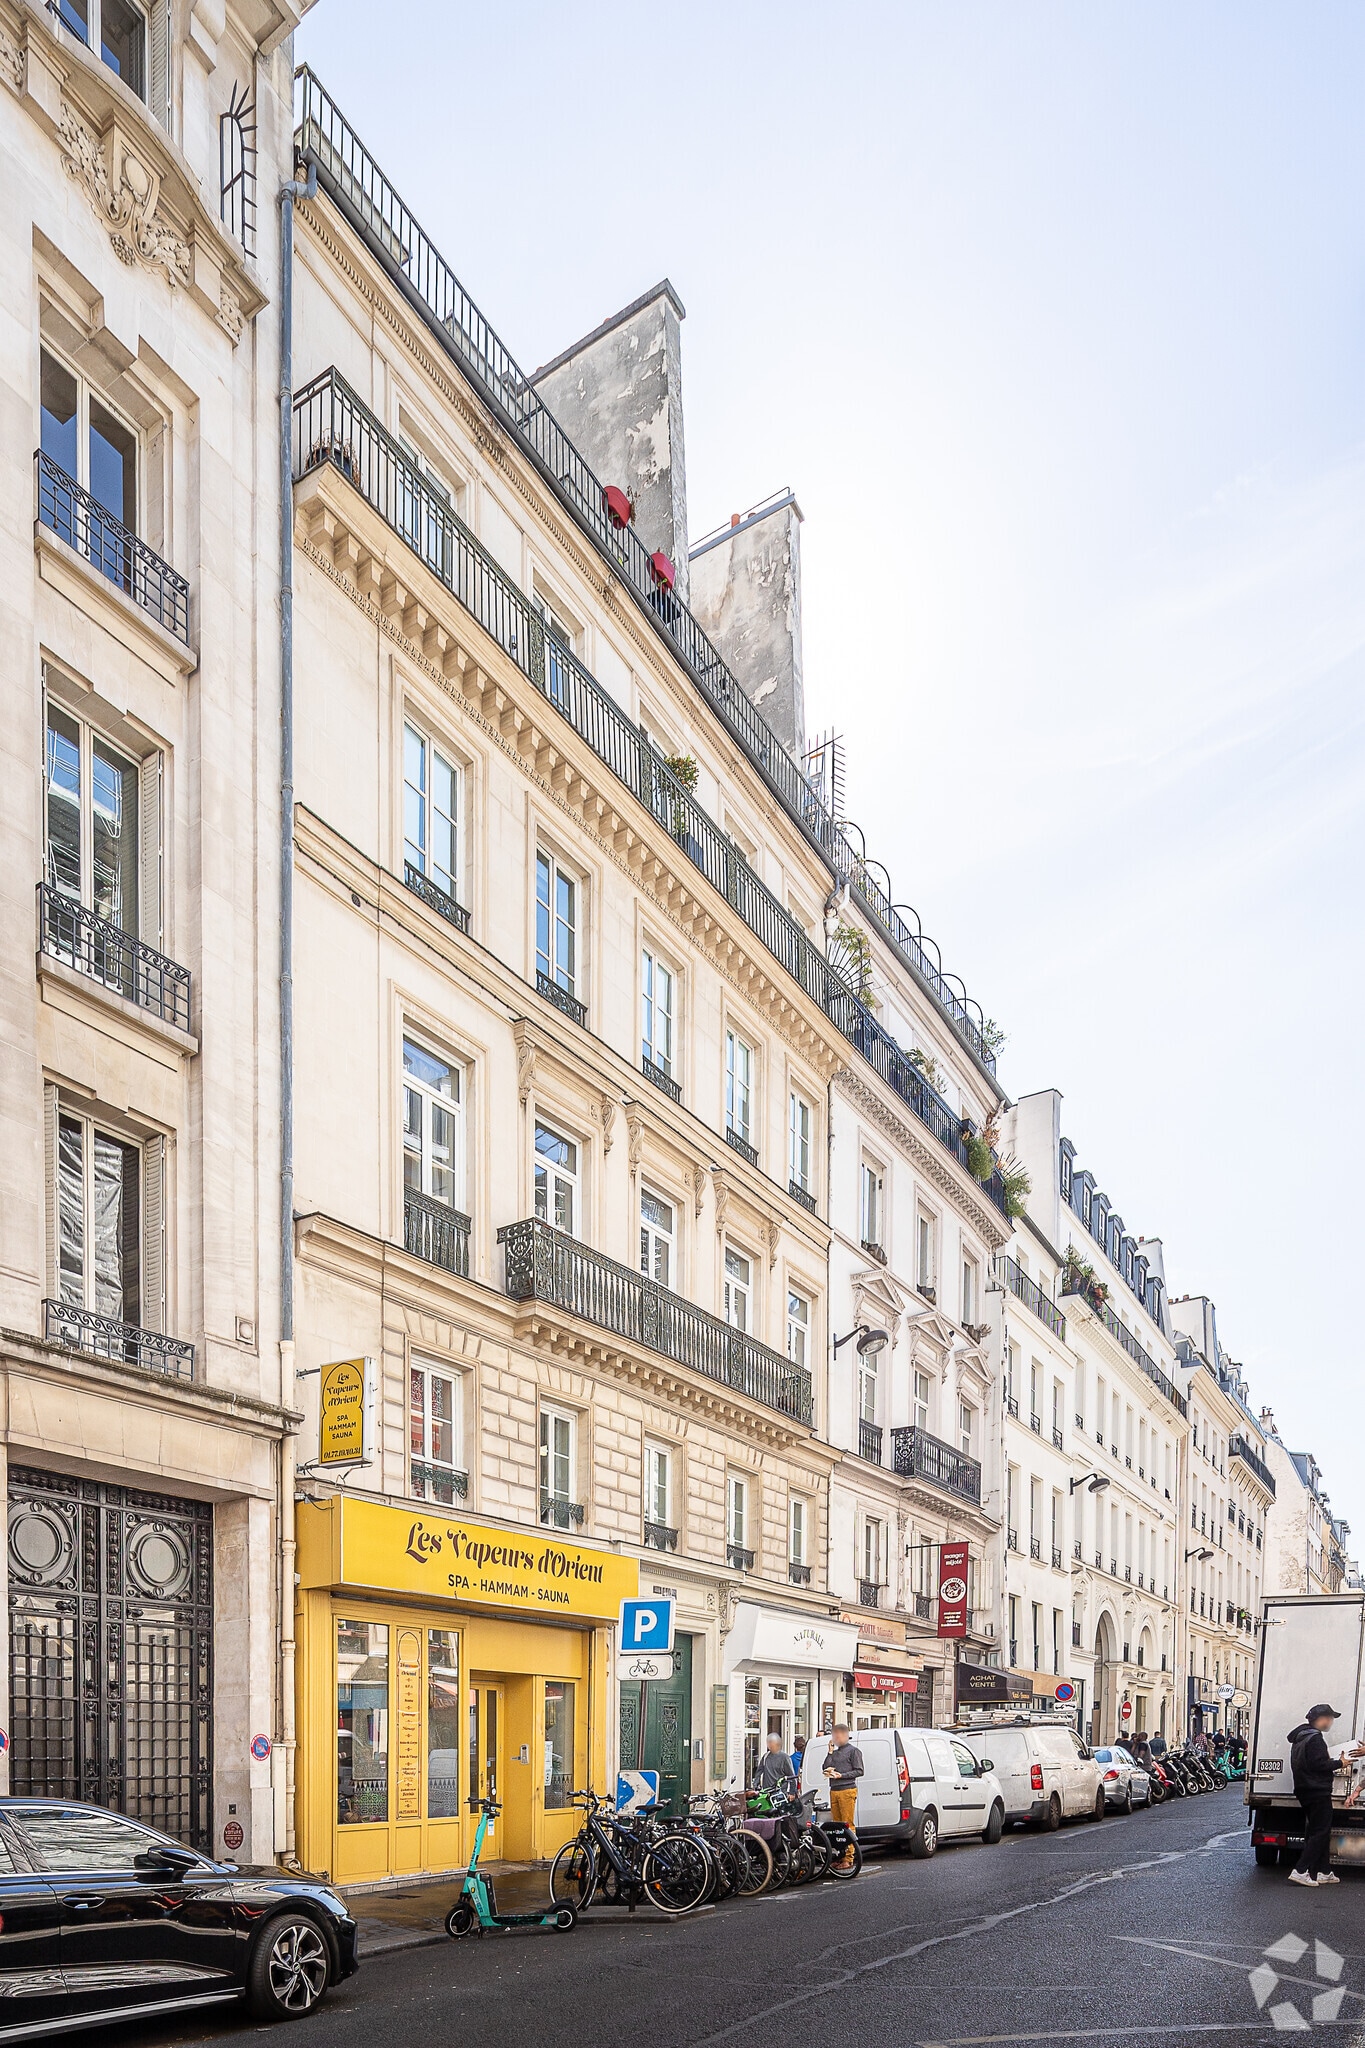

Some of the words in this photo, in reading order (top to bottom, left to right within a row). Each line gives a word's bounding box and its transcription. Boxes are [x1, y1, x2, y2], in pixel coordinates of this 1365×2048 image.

[337, 1373, 350, 1384] Les
[326, 1384, 360, 1396] Vapeurs
[327, 1395, 358, 1407] d'Orient
[336, 1414, 349, 1422] SPA
[328, 1421, 357, 1432] HAMMAM
[331, 1431, 353, 1440] SAUNA
[405, 1522, 443, 1564] Les
[446, 1528, 534, 1570] Vapeurs
[537, 1548, 604, 1584] d'Orient
[448, 1574, 470, 1590] SPA
[480, 1579, 529, 1598] HAMMAM
[537, 1588, 570, 1605] SAUNA
[634, 1609, 658, 1642] P
[1260, 1761, 1281, 1771] 52302
